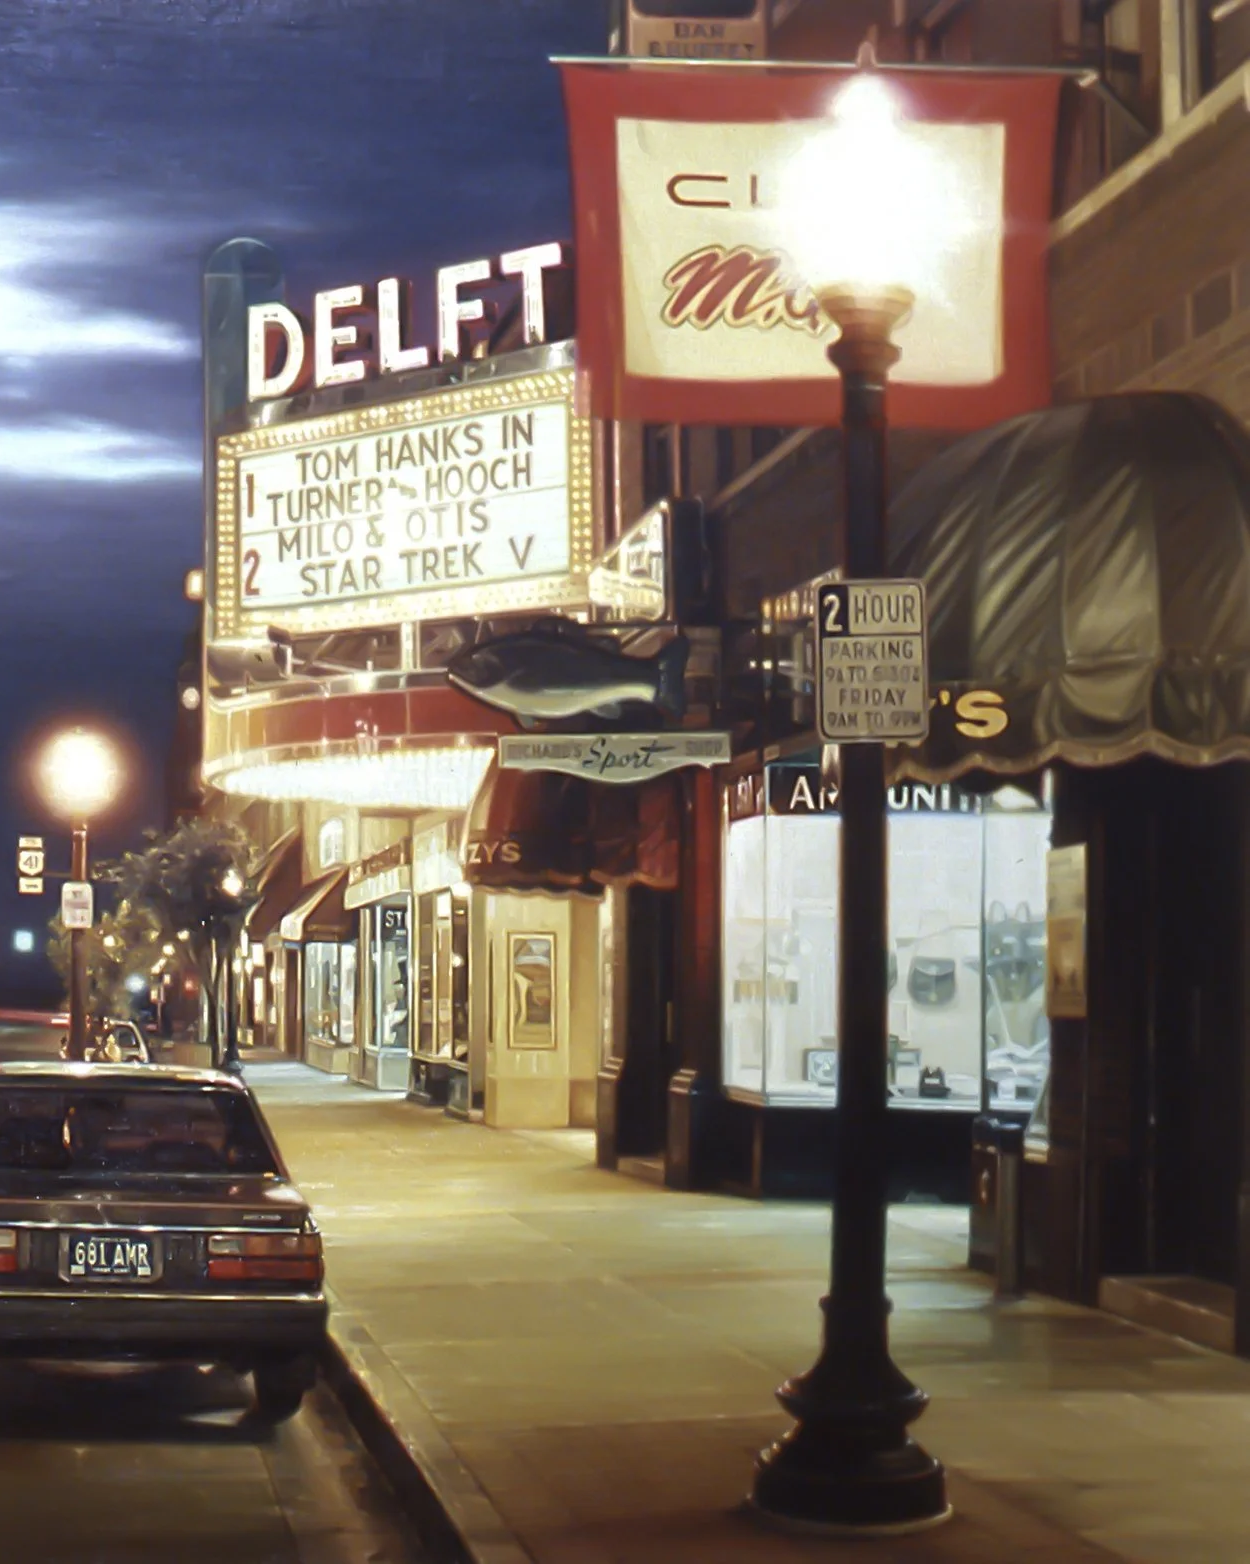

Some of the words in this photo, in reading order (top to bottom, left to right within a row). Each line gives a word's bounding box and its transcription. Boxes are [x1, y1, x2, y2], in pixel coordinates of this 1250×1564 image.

[246, 241, 563, 402] DELFT
[295, 442, 359, 485] TOM
[375, 422, 484, 473] HANKS
[501, 411, 534, 450] IN
[266, 477, 385, 527] TURNER
[424, 451, 533, 502] HOOCH
[277, 519, 354, 562] MILO
[365, 513, 386, 548] &
[405, 498, 491, 542] OTIS
[243, 548, 262, 597] 2
[300, 554, 382, 597] STAR
[398, 541, 484, 585] TREK
[508, 534, 536, 571] V
[822, 593, 844, 633] 2
[854, 594, 916, 625] HOUR
[829, 639, 914, 661] PARKING
[838, 688, 907, 707] FRIDAY
[928, 689, 1009, 739] 'S
[864, 711, 884, 729] TO
[582, 736, 676, 774] Sport
[22, 855, 39, 870] 41
[75, 1241, 107, 1266] 681
[113, 1243, 149, 1268] AMR
